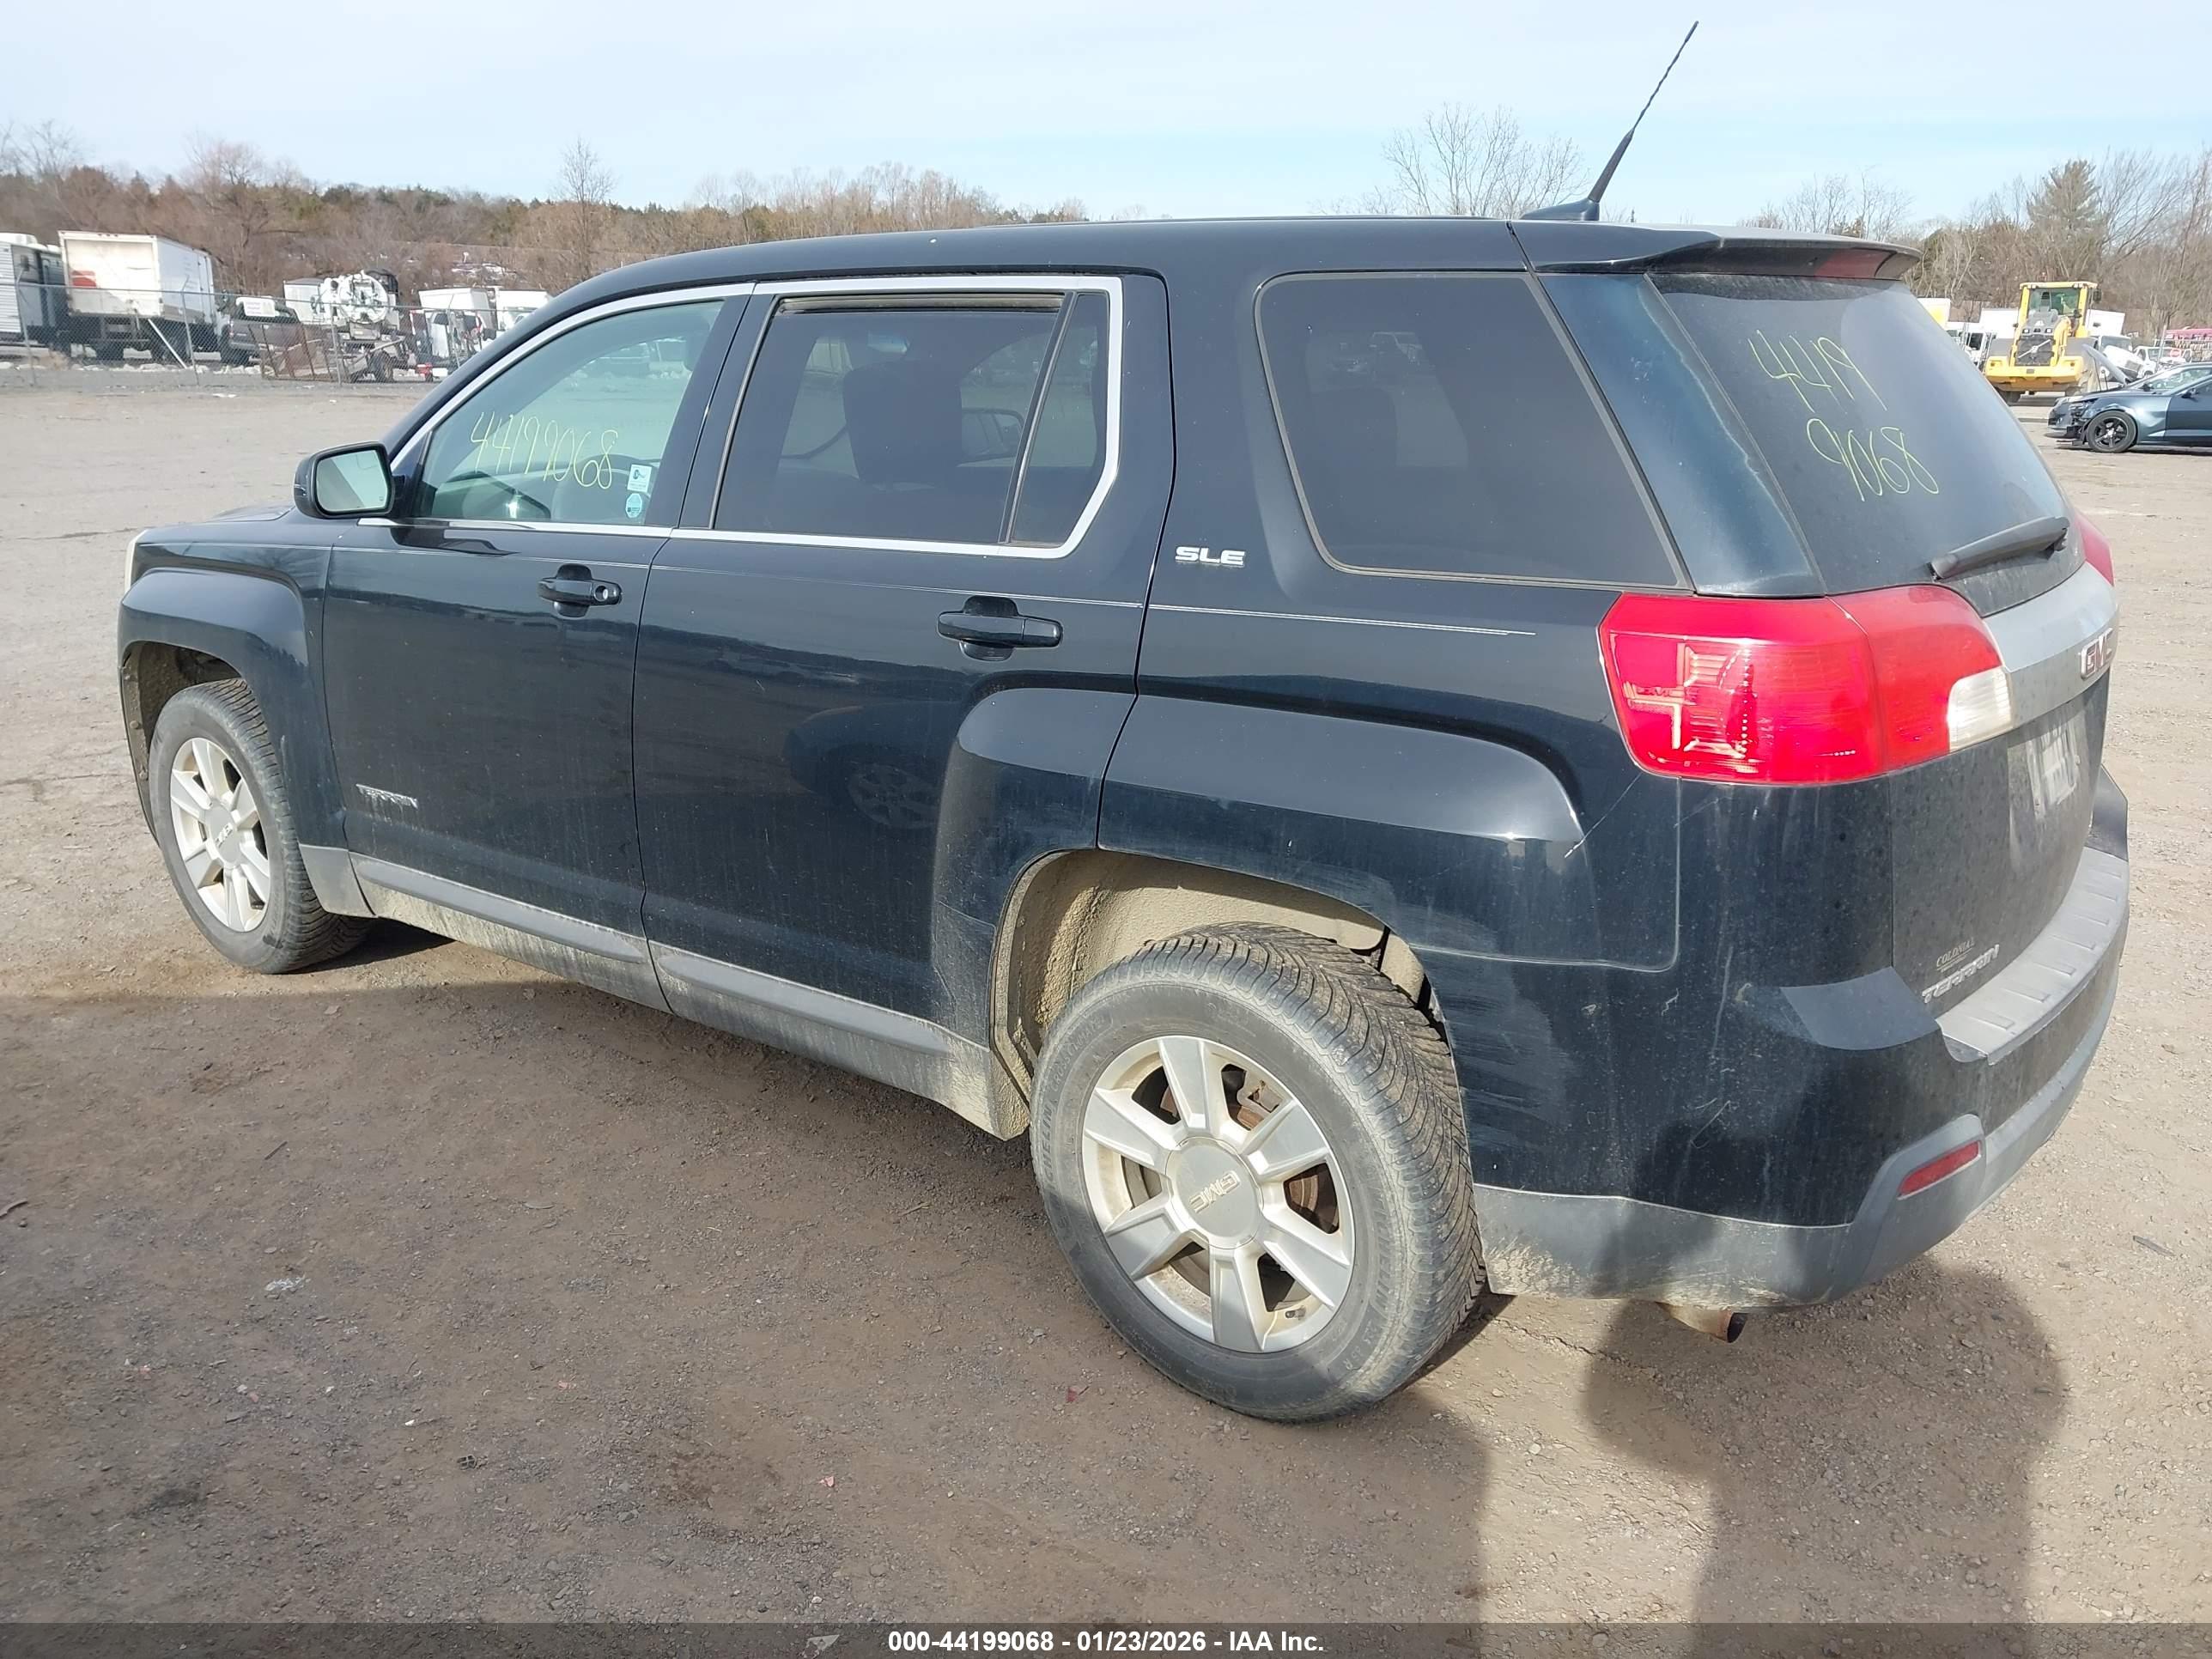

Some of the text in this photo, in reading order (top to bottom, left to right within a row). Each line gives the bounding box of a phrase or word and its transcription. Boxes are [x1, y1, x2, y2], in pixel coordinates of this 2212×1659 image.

[1747, 329, 1888, 414] 4419
[470, 410, 619, 489] 44199068
[1806, 417, 1940, 501] 9068
[1175, 546, 1246, 567] SLE
[2080, 627, 2114, 678] GMC
[1188, 1170, 1242, 1214] GMC
